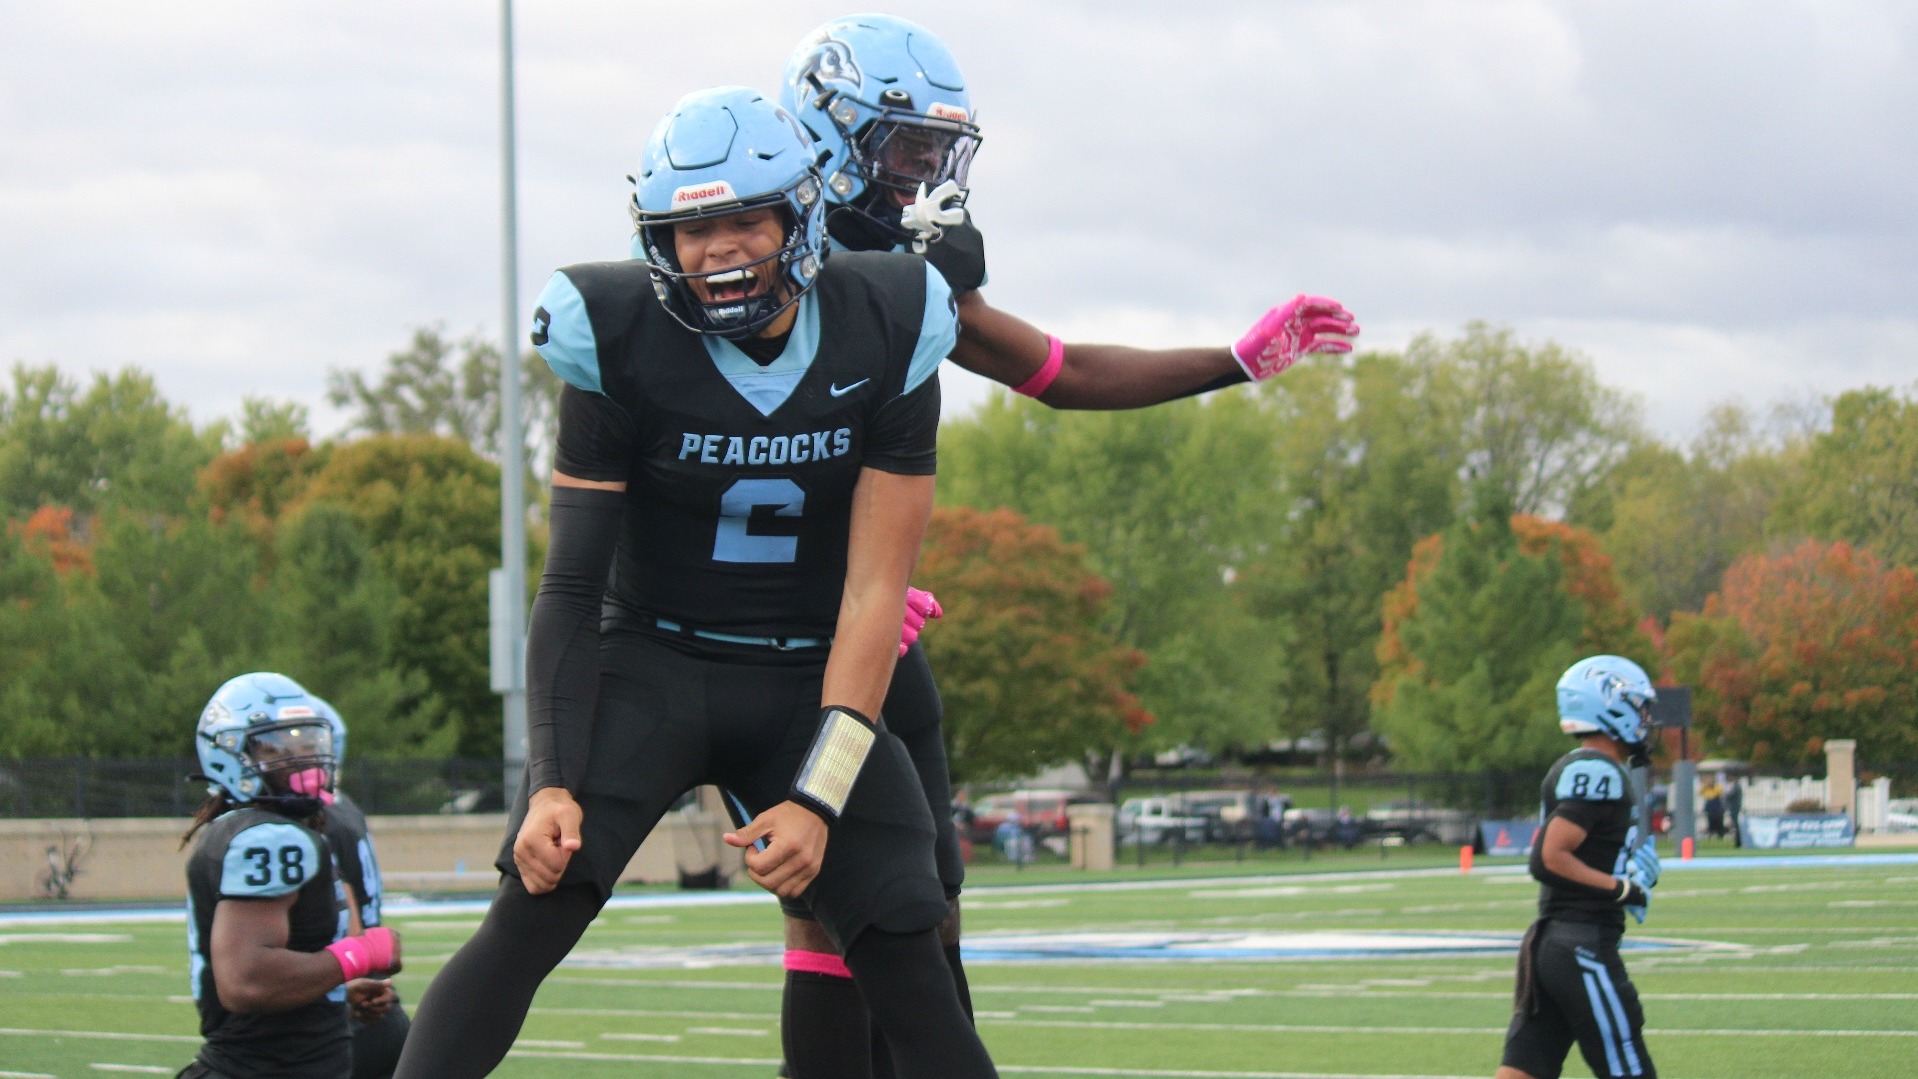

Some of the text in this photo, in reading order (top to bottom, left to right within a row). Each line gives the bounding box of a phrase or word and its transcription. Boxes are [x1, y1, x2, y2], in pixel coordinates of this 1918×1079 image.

[677, 185, 725, 202] Riddell
[718, 305, 744, 315] Riddell
[678, 428, 851, 465] PEACOCKS
[711, 478, 806, 563] 2
[1572, 772, 1611, 799] 84
[244, 845, 304, 886] 38
